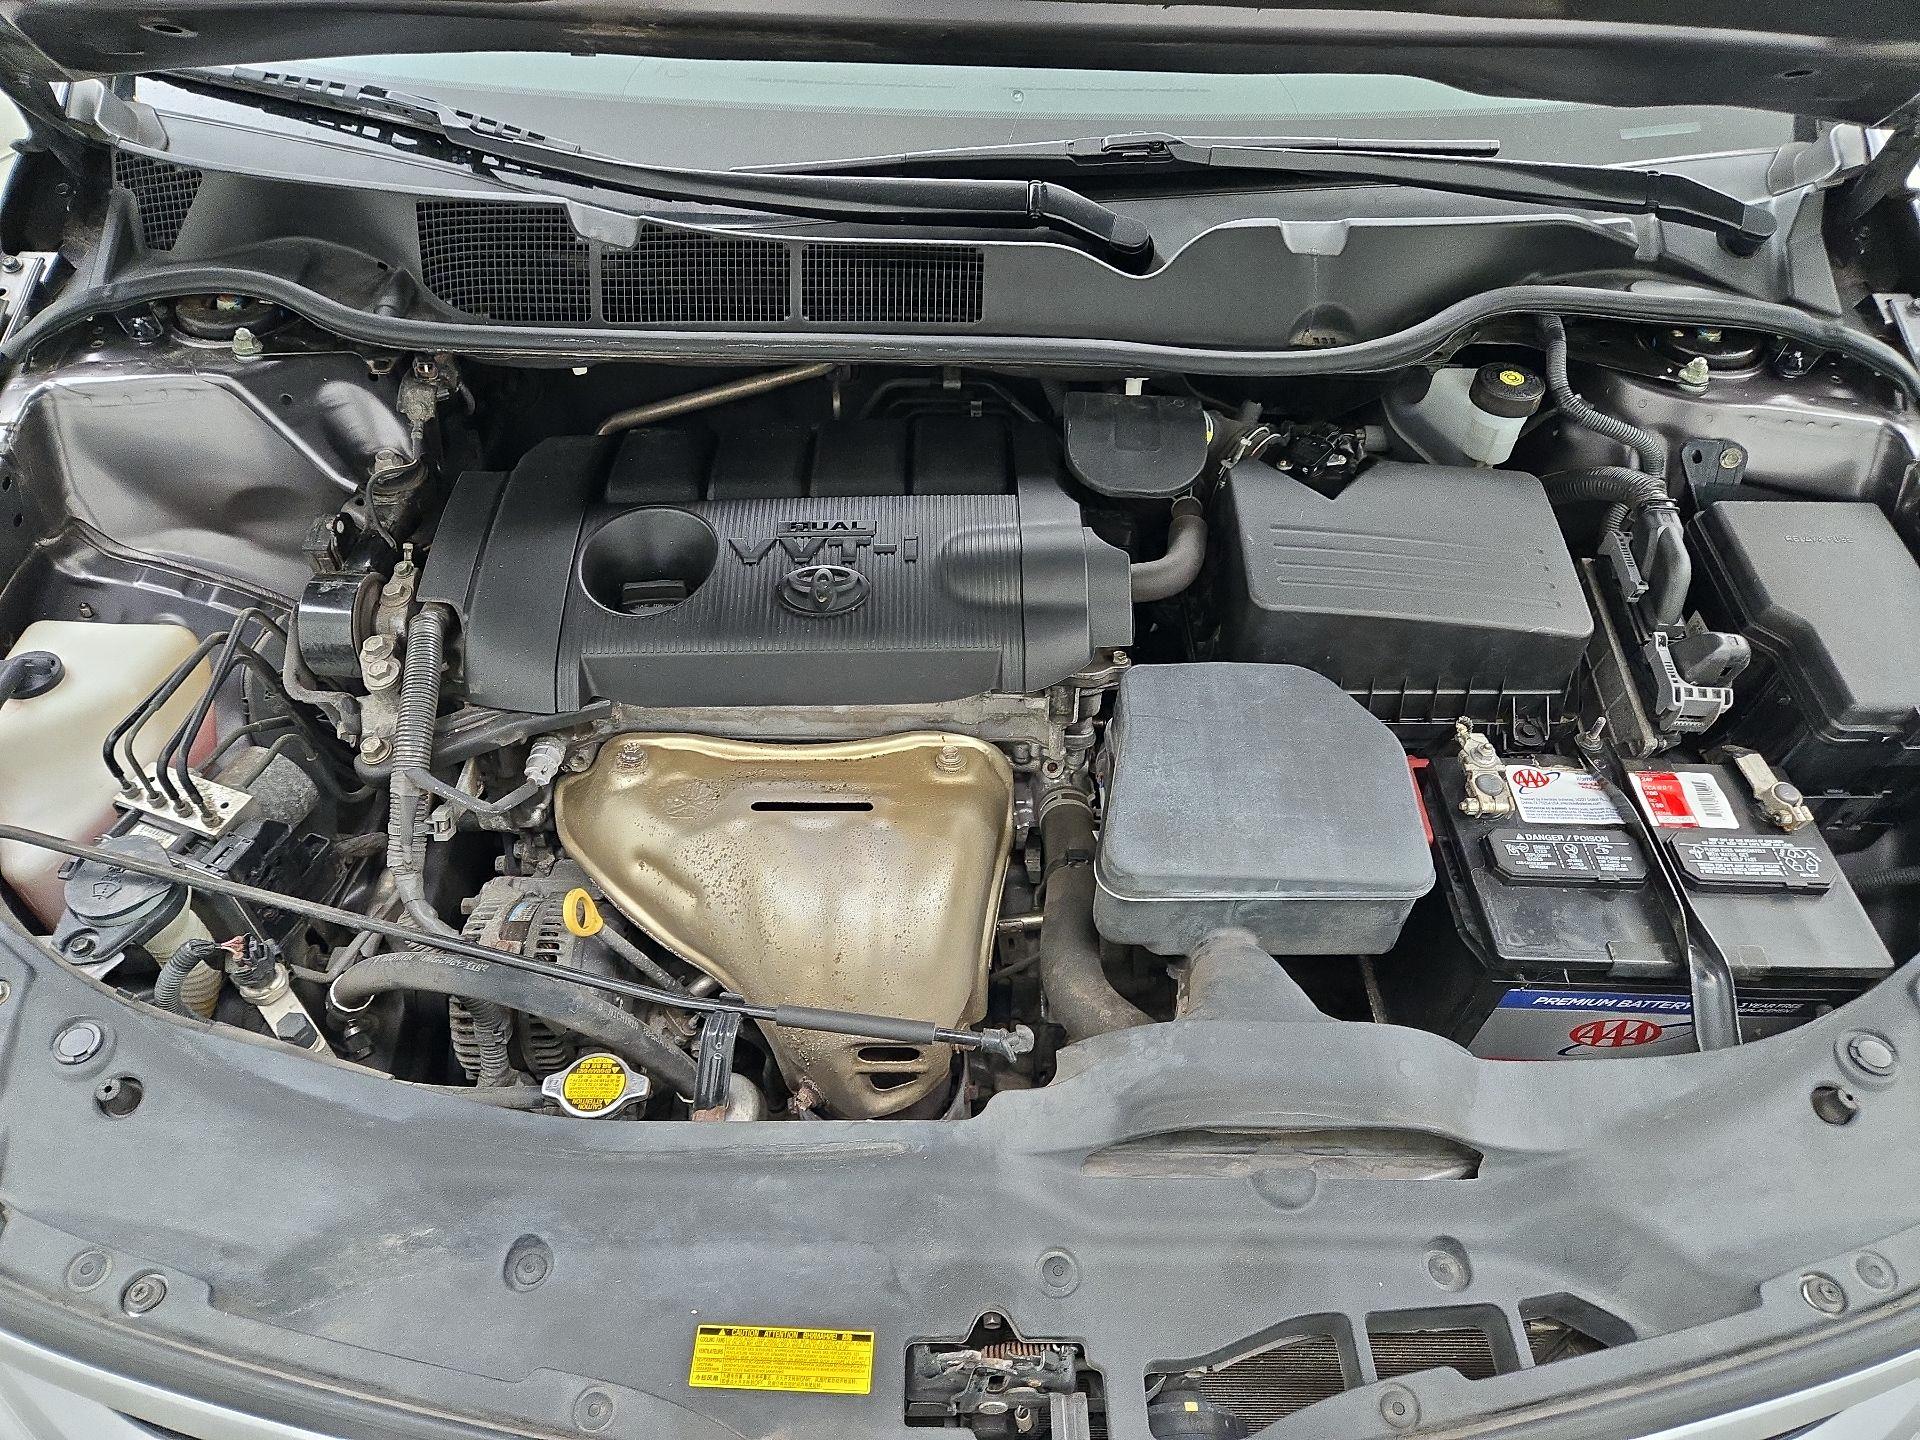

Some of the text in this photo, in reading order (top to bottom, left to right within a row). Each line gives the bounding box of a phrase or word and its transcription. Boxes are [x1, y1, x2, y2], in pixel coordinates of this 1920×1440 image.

[789, 521, 867, 531] DUAL
[1513, 769, 1550, 788] AAA
[1525, 833, 1564, 841] DANGER
[1533, 996, 1619, 1008] PREMIUM
[1574, 1020, 1659, 1047] AAA
[731, 1328, 798, 1339] CAUTION ATTENTION
